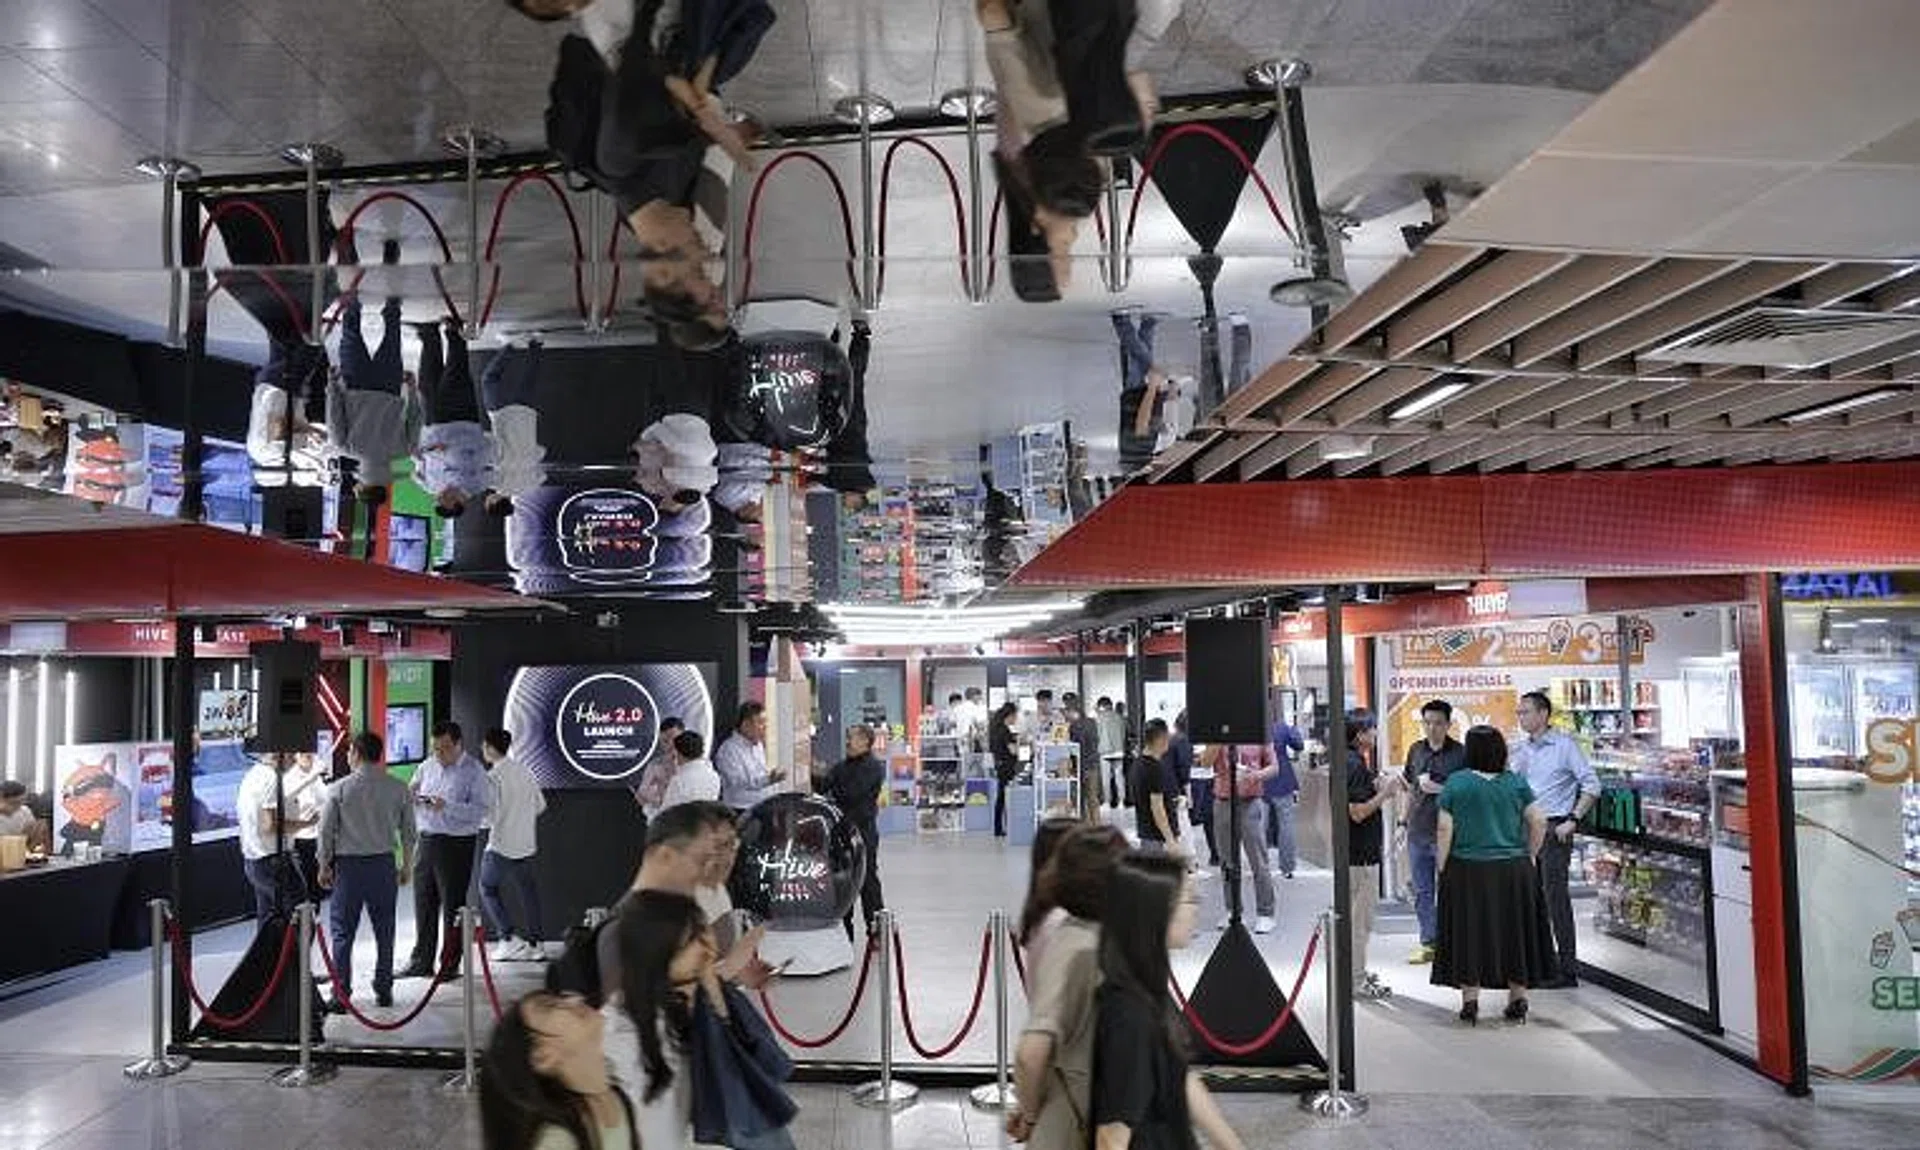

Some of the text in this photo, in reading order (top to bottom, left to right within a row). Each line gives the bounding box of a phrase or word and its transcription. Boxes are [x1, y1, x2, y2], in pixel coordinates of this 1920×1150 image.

[135, 627, 169, 641] HIVE
[1480, 626, 1505, 666] 2
[1577, 622, 1602, 663] 3
[1389, 674, 1512, 689] OPENING SPECIALS
[573, 701, 643, 723] Hive 2.0
[583, 726, 633, 737] LAUNCH
[1865, 717, 1920, 783] S
[757, 838, 828, 880] Hive
[1872, 976, 1920, 1010] SE
